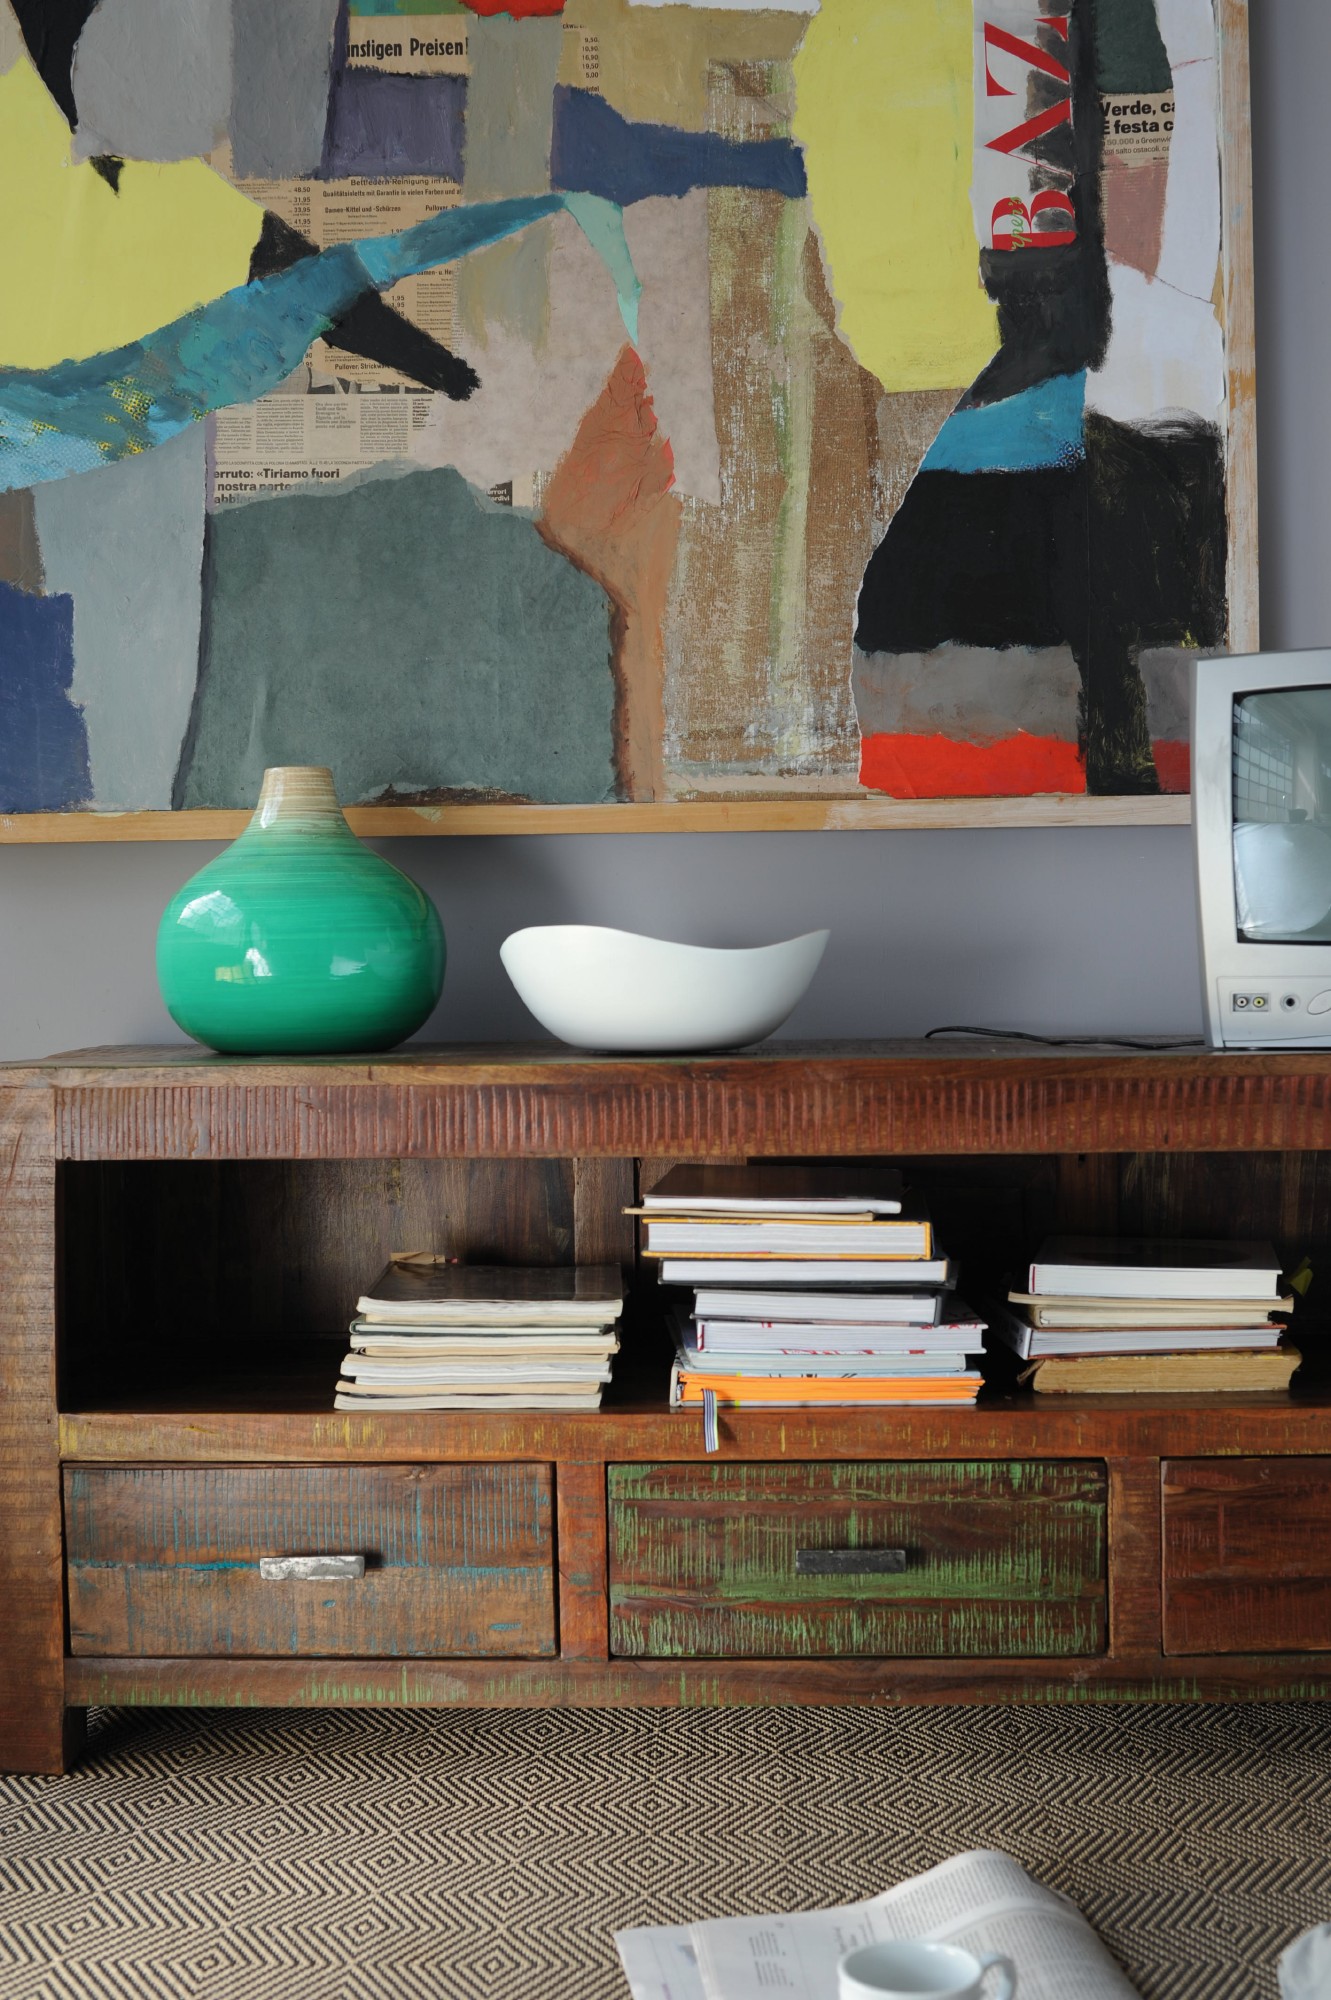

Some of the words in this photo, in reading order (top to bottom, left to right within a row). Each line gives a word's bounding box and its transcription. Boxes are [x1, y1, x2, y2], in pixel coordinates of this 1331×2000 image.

[410, 37, 469, 56] Preisen!
[1100, 101, 1156, 116] Verde,
[984, 17, 1077, 249] BAZ
[1114, 119, 1160, 134] festa
[256, 468, 309, 479] «Tiriamo
[310, 468, 340, 479] fuori
[217, 482, 257, 491] nostra
